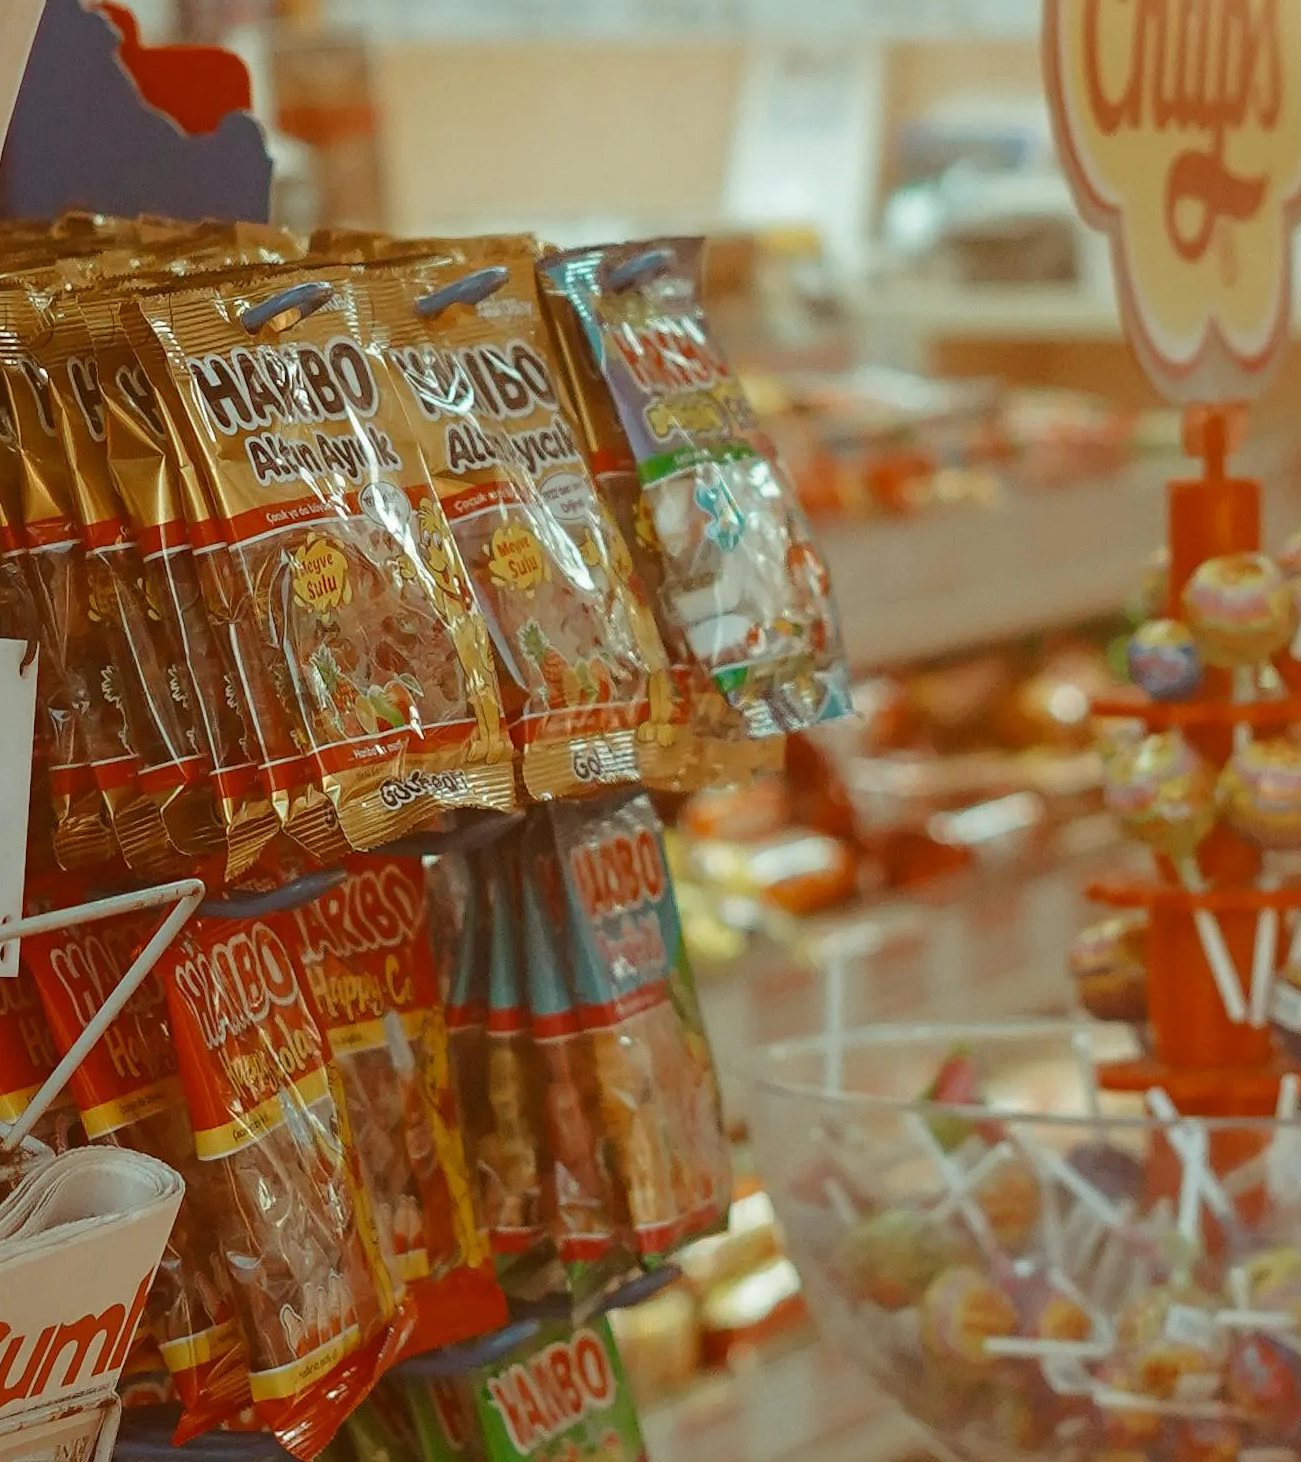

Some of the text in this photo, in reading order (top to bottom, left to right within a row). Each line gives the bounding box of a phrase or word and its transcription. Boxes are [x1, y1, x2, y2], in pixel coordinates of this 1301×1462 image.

[497, 535, 532, 559] Meyve
[506, 554, 539, 581] Sulu
[306, 573, 339, 602] Sulu
[300, 865, 423, 964] ARIBO
